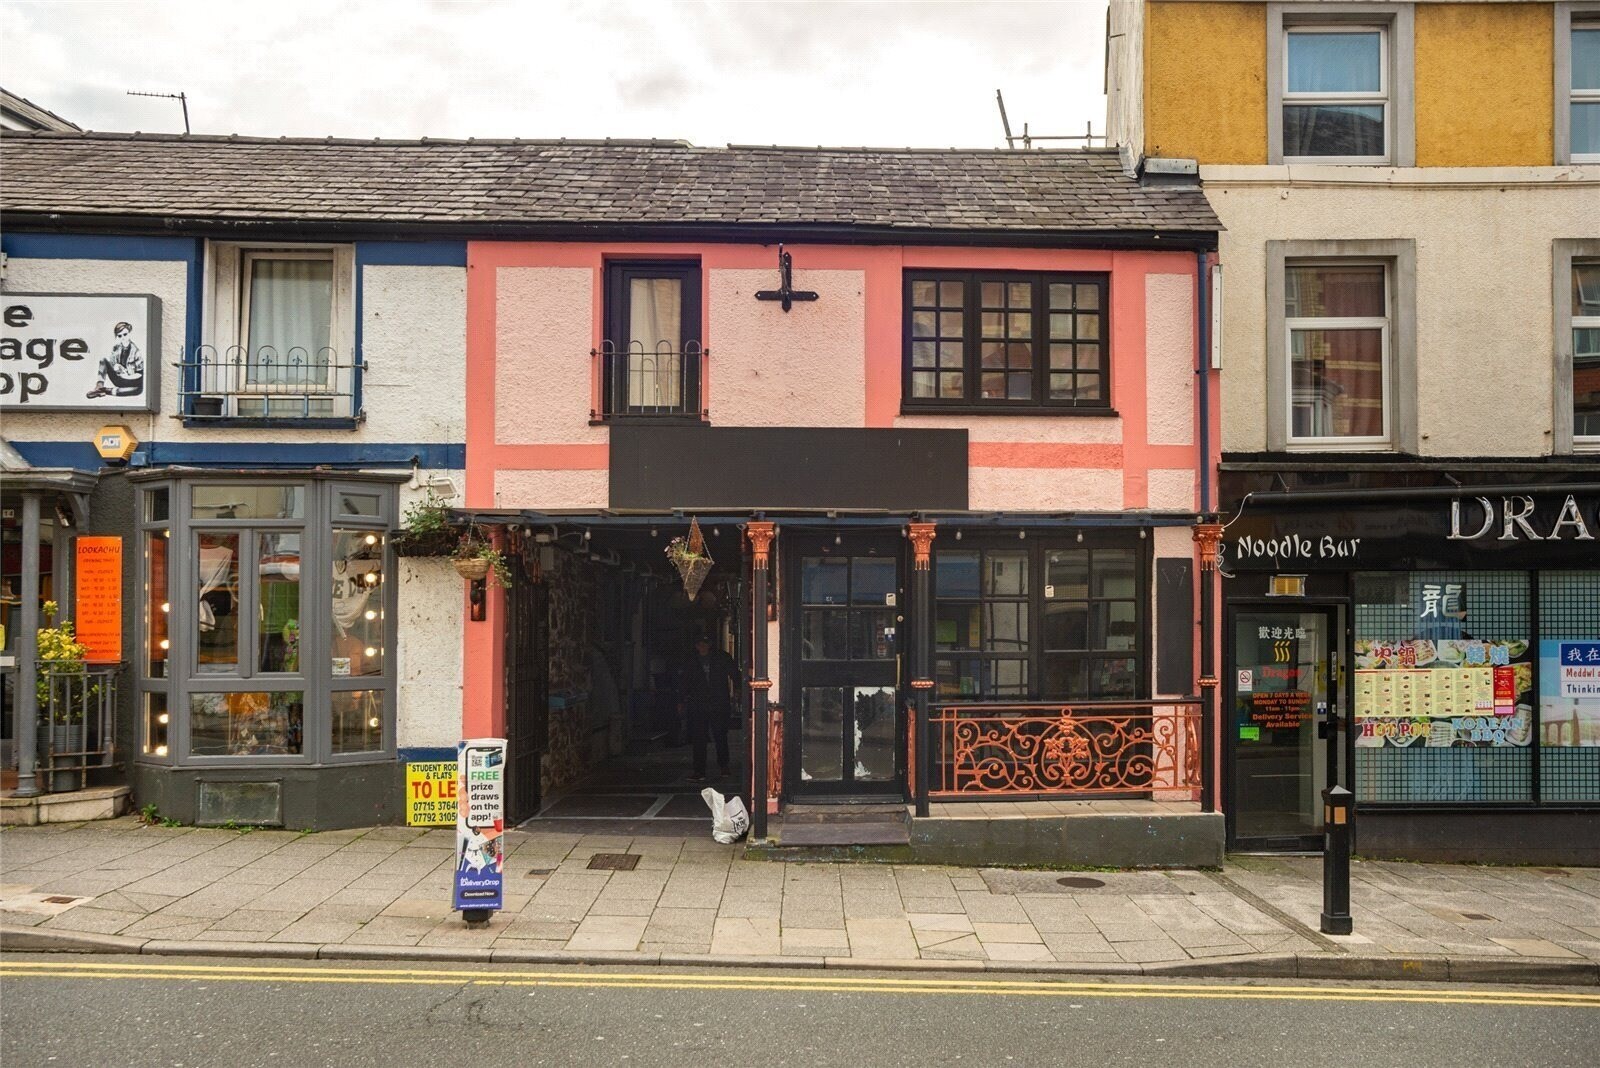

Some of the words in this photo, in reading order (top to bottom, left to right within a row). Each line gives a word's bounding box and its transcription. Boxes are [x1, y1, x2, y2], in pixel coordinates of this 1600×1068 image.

[102, 437, 121, 447] ADT
[1446, 494, 1600, 541] DRA
[78, 546, 120, 554] LOOKACHU
[1237, 533, 1312, 560] Noodle
[1319, 535, 1361, 559] Bar
[1420, 583, 1467, 620] 龍
[1258, 626, 1307, 640] 歡迎光臨
[1374, 646, 1416, 666] 火鍋
[1567, 647, 1600, 662] 我在
[1566, 667, 1595, 678] Meddwl
[1451, 717, 1524, 730] KOREAN
[1363, 723, 1398, 737] HOT
[1400, 723, 1432, 737] POT
[1471, 729, 1506, 745] BBQ
[412, 764, 441, 772] STUDENT
[444, 763, 458, 771] ROO
[426, 772, 431, 780] &
[471, 771, 499, 780] FREE
[412, 781, 432, 799] TO
[438, 780, 458, 798] LE
[471, 783, 493, 791] prize
[413, 802, 435, 811] 07715
[413, 813, 436, 822] 07792
[471, 813, 491, 821] app!
[460, 878, 500, 887] DeliveryDrop
